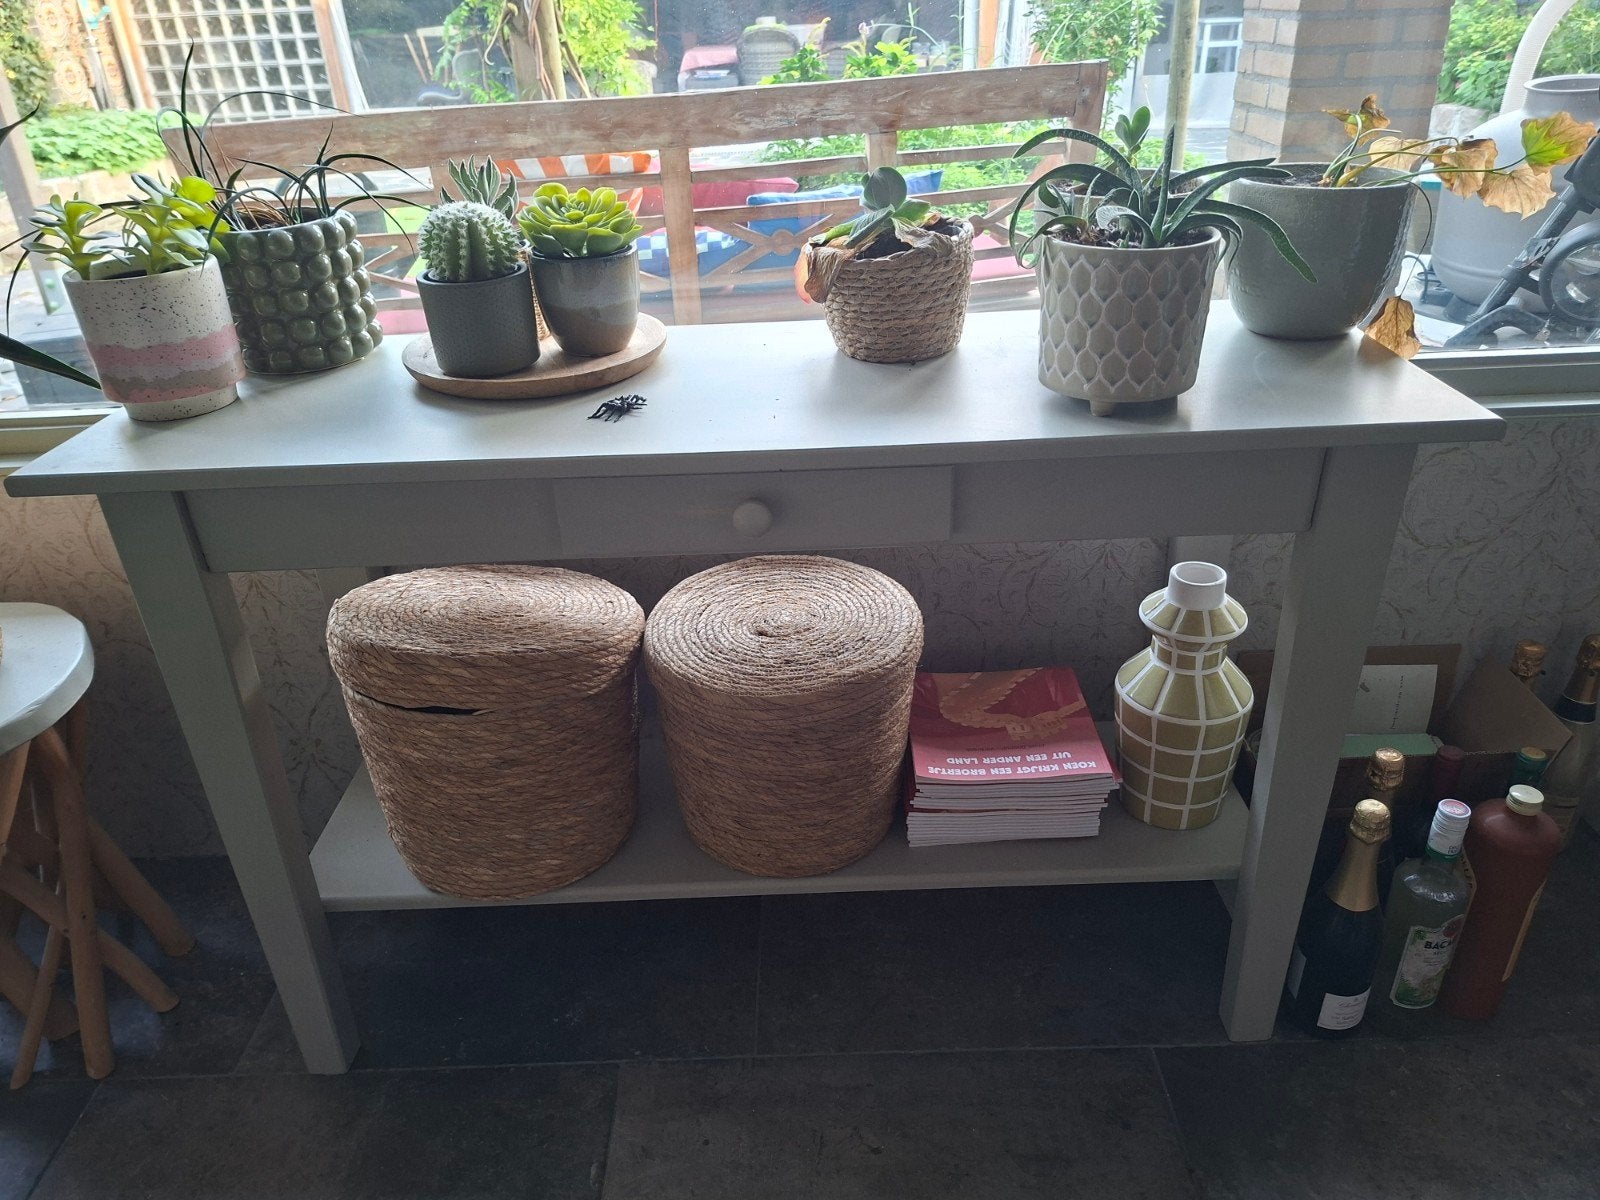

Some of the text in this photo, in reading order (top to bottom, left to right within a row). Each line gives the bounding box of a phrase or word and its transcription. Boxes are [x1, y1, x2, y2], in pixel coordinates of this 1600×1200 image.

[946, 751, 1072, 765] UIT EEN ANDER LAND
[927, 761, 1097, 776] KOEN KRIJGT EEN BROERTJE
